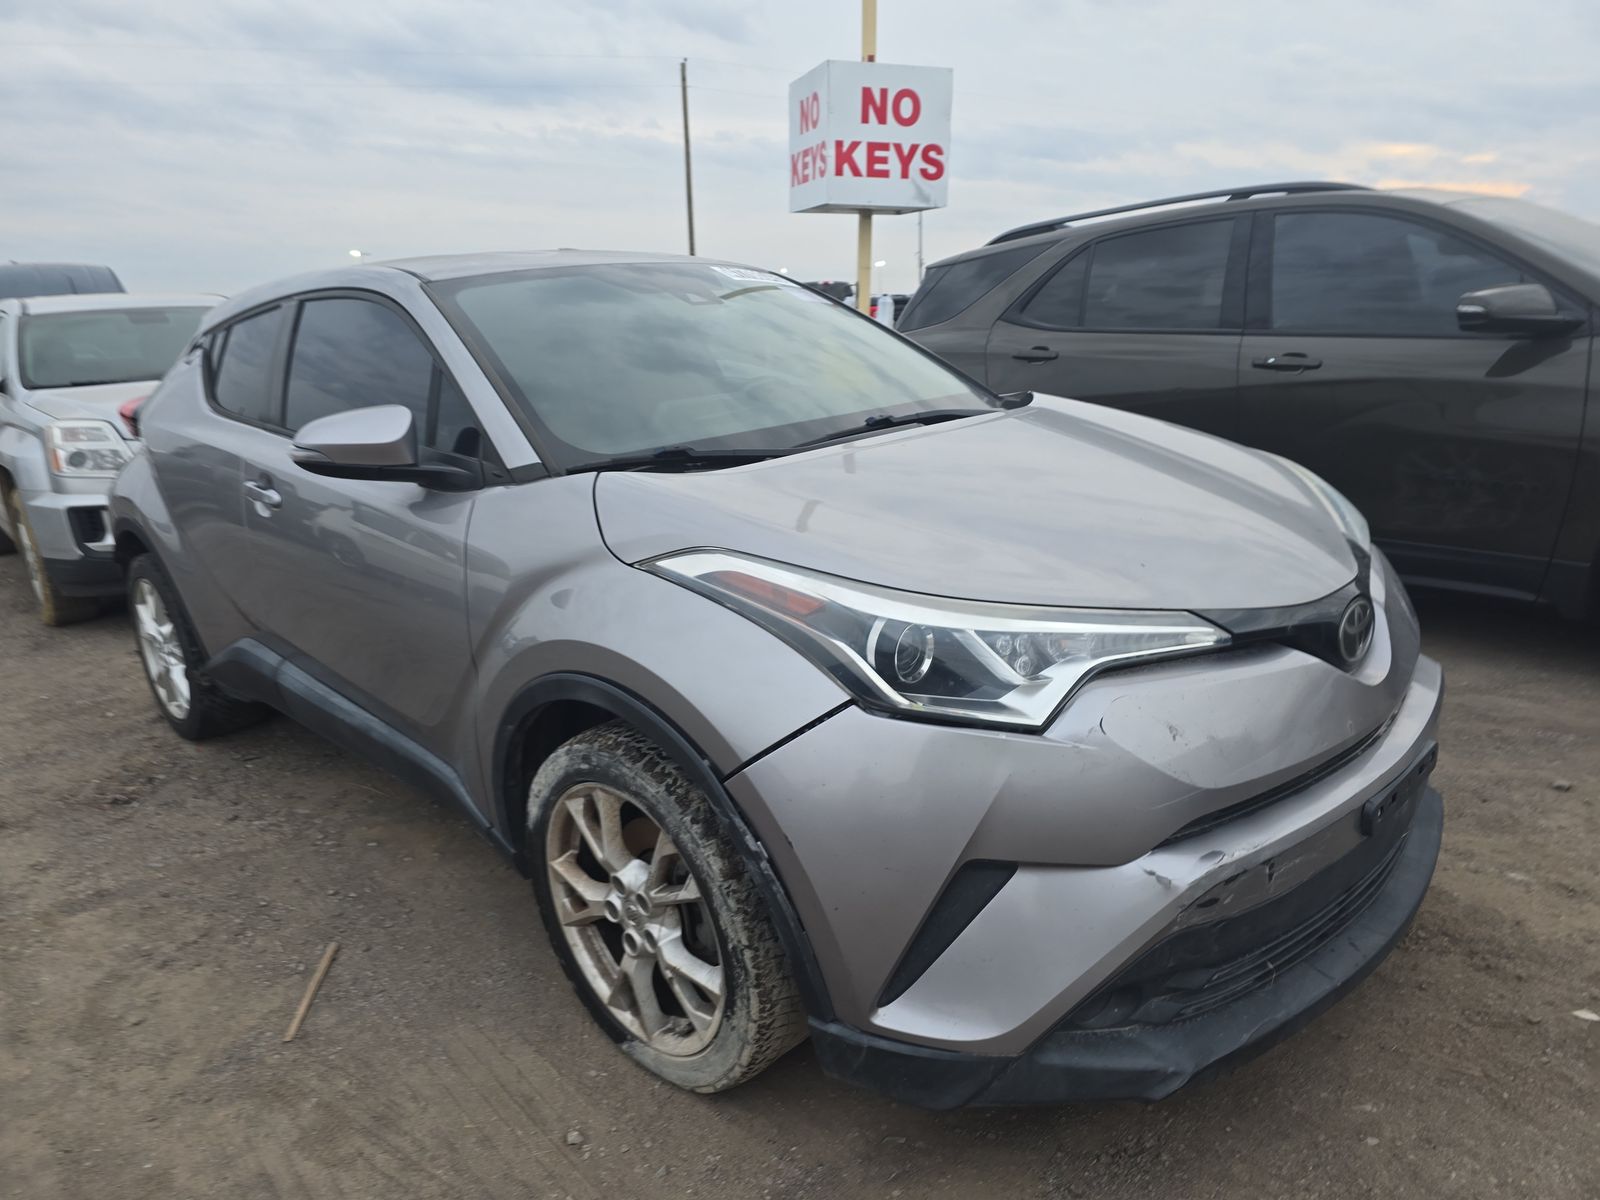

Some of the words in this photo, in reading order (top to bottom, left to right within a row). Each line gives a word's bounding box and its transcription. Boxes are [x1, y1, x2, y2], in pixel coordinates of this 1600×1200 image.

[799, 91, 820, 135] NO
[861, 86, 922, 127] NO
[790, 140, 827, 187] KEYS
[834, 139, 944, 181] KEYS
